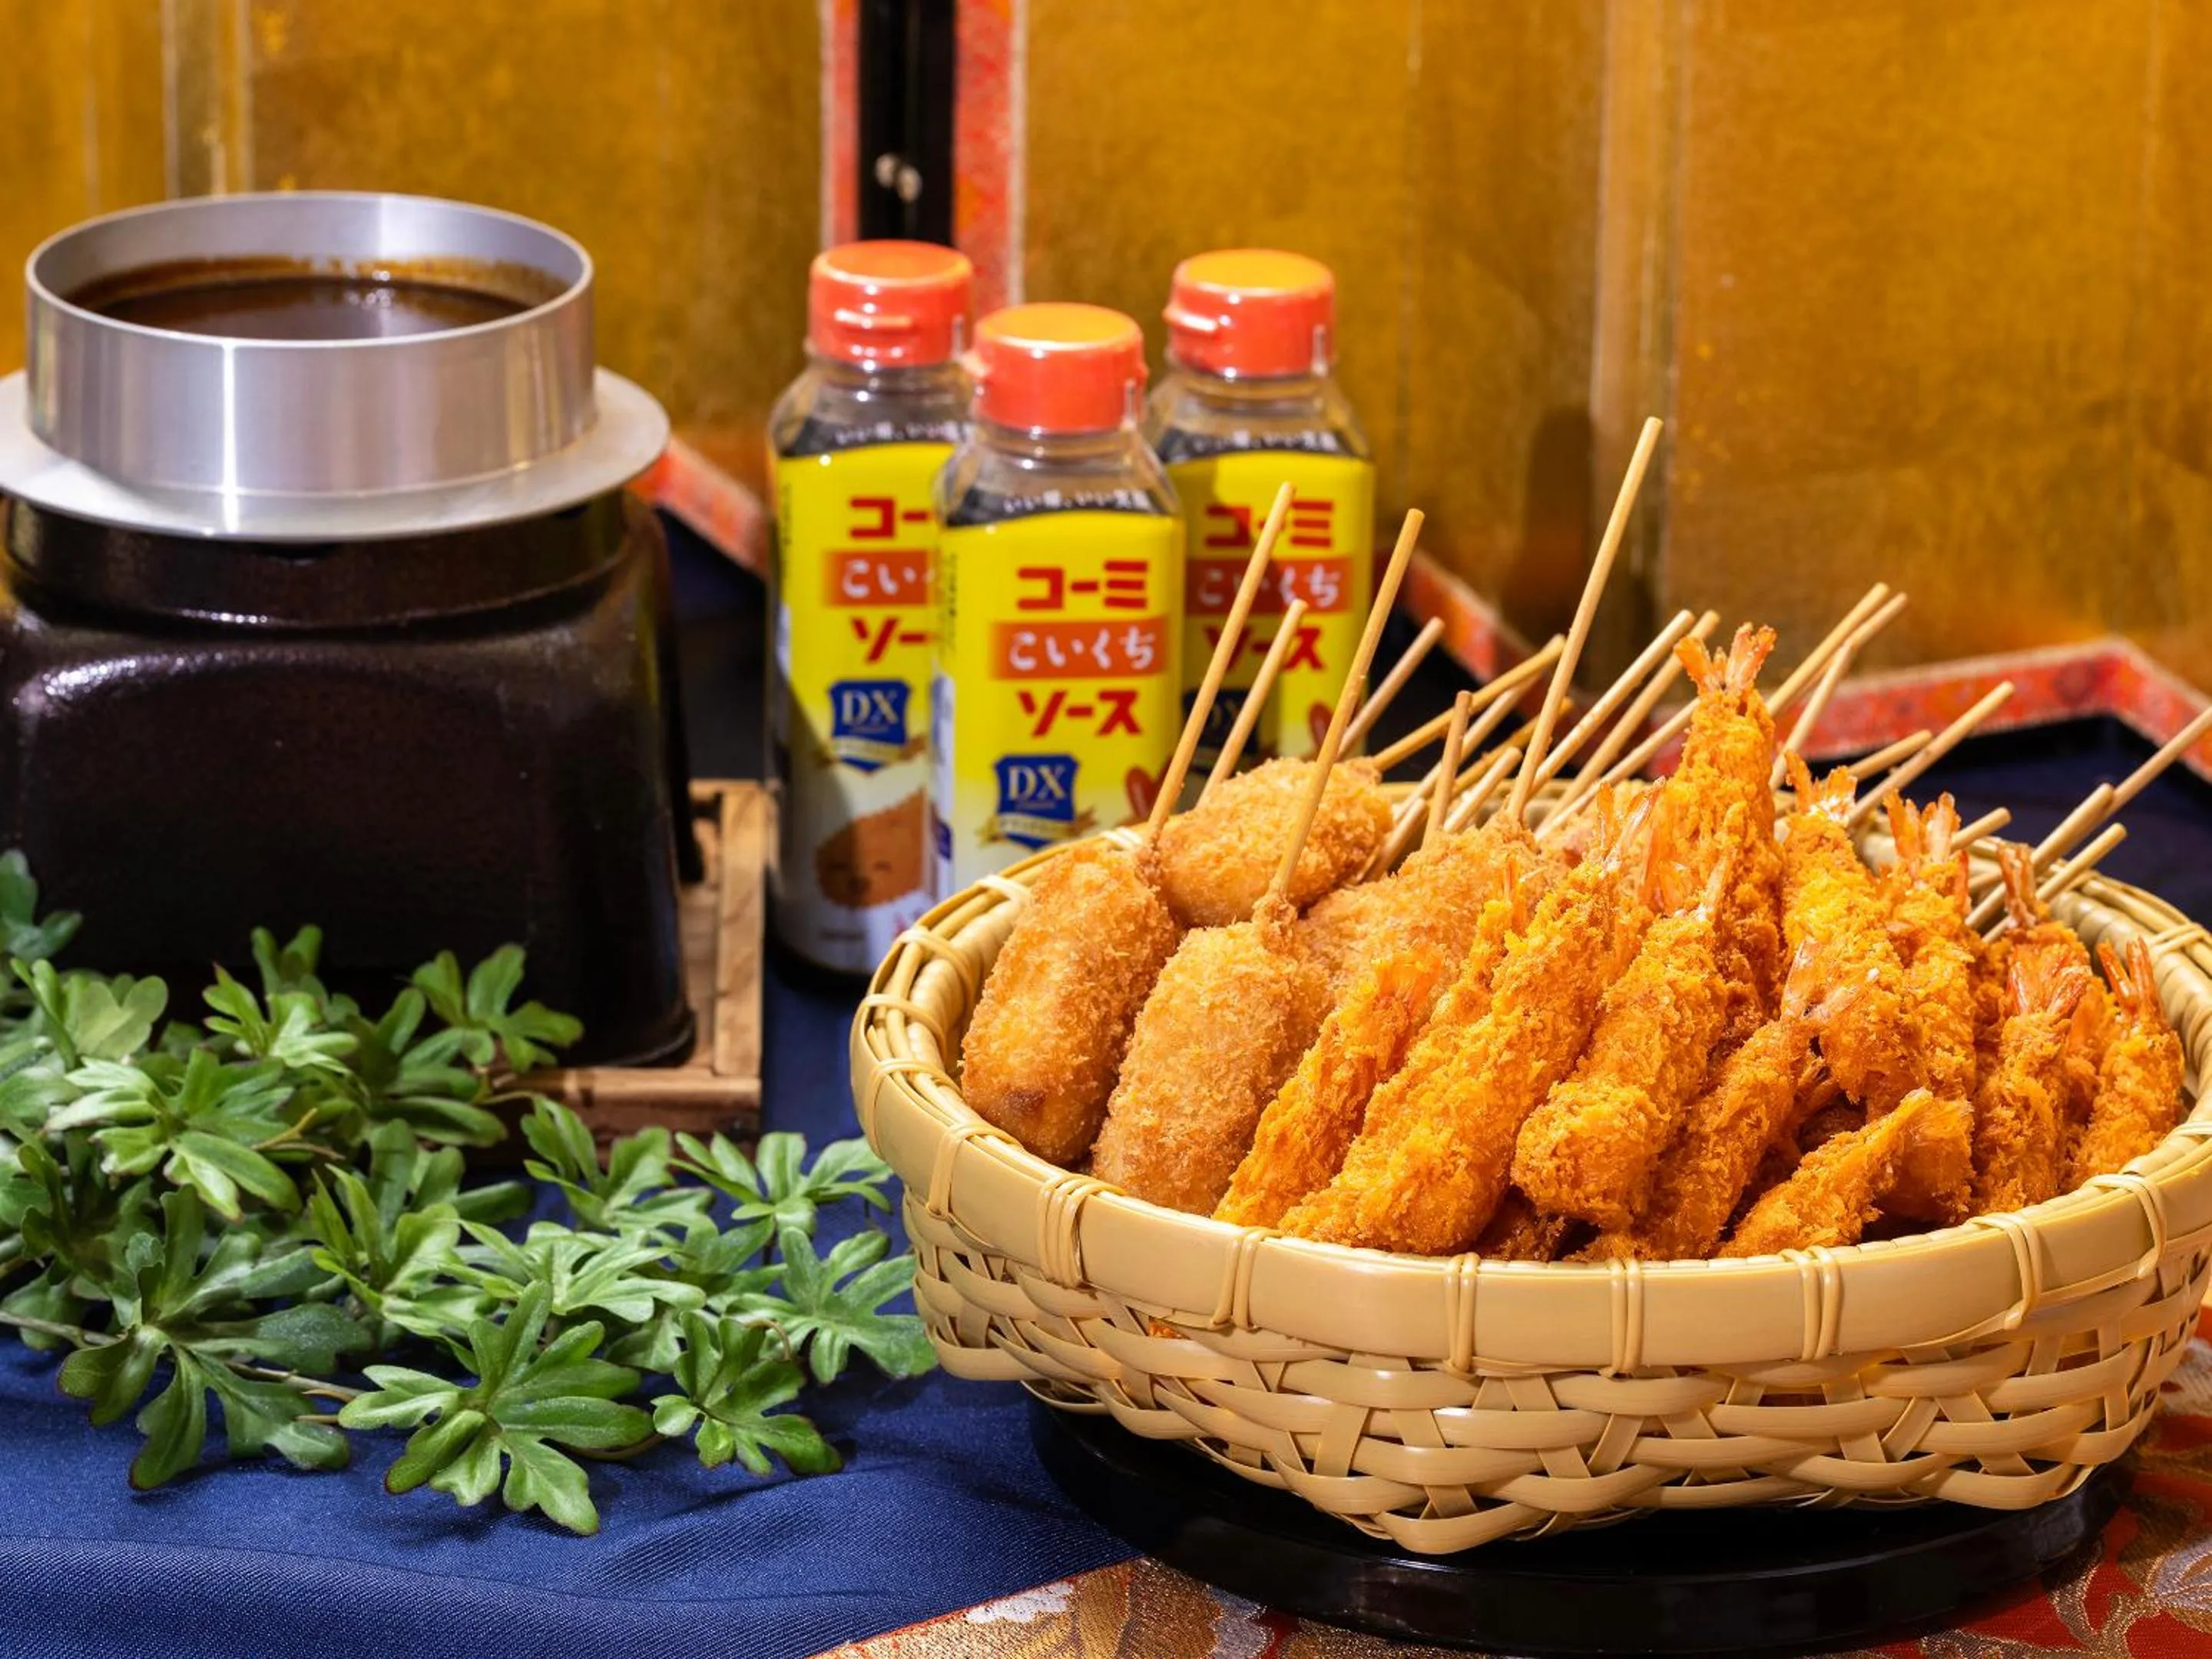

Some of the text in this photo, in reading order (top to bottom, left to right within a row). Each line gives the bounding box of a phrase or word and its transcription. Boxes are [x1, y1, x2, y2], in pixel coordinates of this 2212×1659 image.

[850, 497, 930, 538] コー
[842, 558, 932, 599] こい
[1016, 560, 1149, 611] コーミ
[850, 618, 930, 662] ソー
[1009, 625, 1156, 671] こいくち
[842, 689, 899, 726] DX
[1016, 689, 1142, 737] ソース
[1008, 764, 1067, 800] DX
